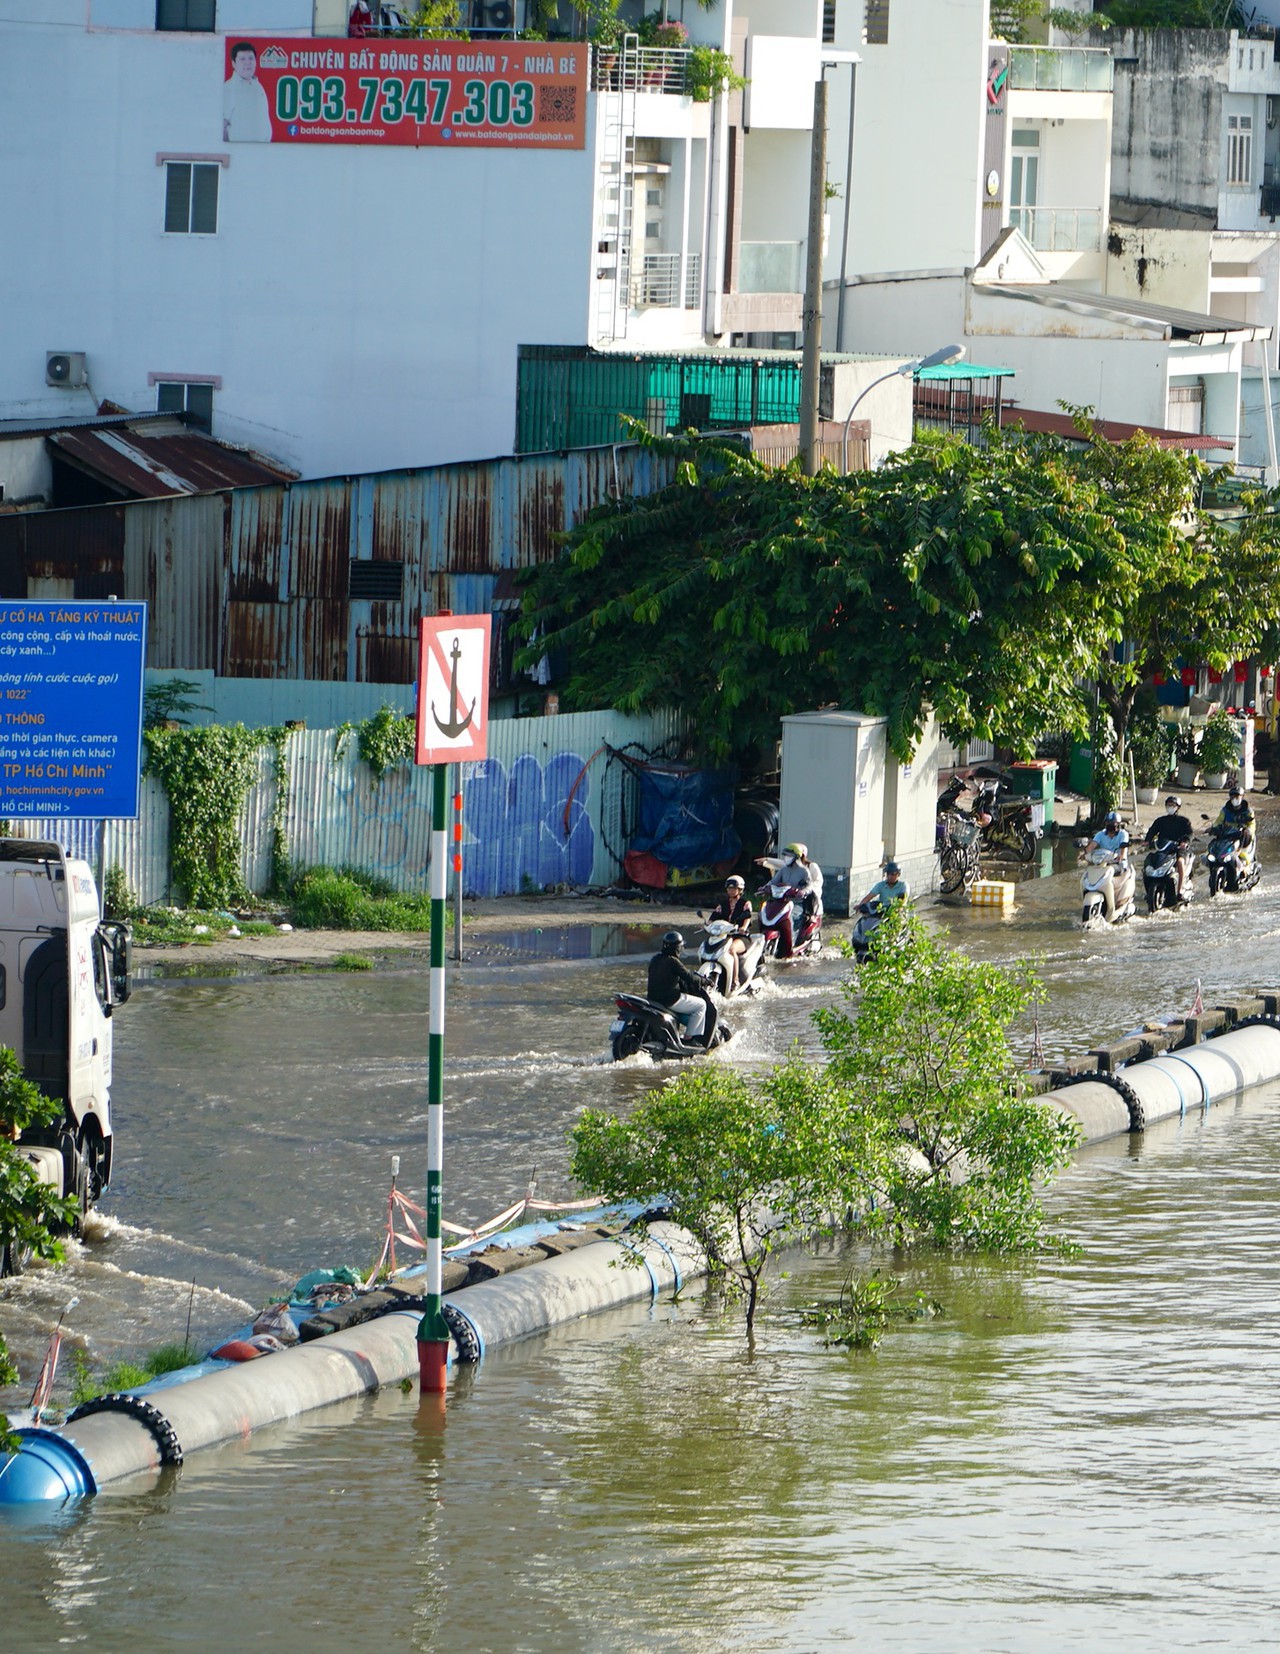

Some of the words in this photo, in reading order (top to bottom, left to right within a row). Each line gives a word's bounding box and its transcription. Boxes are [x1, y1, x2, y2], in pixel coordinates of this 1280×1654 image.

[291, 49, 345, 70] CHUYÊN
[349, 48, 375, 70] BẤT
[380, 50, 418, 73] ĐỘNG
[423, 48, 452, 72] SẢN
[457, 52, 495, 75] QUẬN
[501, 56, 508, 72] 7
[524, 53, 554, 74] NHÀ
[559, 53, 576, 75] BÈ
[276, 75, 535, 127] 093.7347.303
[9, 608, 27, 623] CỐ
[28, 611, 45, 625] HẠ
[84, 610, 100, 623] KỸ
[103, 609, 140, 625] THUẬT
[1, 631, 24, 642] công
[55, 630, 72, 642] cấp
[74, 630, 85, 640] và
[88, 631, 111, 641] thoát
[0, 645, 17, 657] cây
[23, 672, 43, 683] tính
[45, 673, 69, 683] cước
[71, 673, 96, 685] cuộc
[97, 673, 119, 685] gọi)
[5, 711, 45, 725] THÔNG
[11, 732, 30, 743] thời
[32, 733, 53, 745] gian
[81, 734, 118, 743] camera
[20, 748, 31, 758] và
[33, 747, 49, 758] các
[51, 748, 69, 760] tiện
[72, 748, 86, 758] ích
[88, 748, 116, 758] khác)
[3, 764, 21, 778] TP
[25, 763, 44, 778] Hồ
[46, 764, 69, 778] Chí
[2, 799, 16, 812] HỒ
[17, 800, 35, 812] CHÍ
[36, 802, 62, 812] MINH
